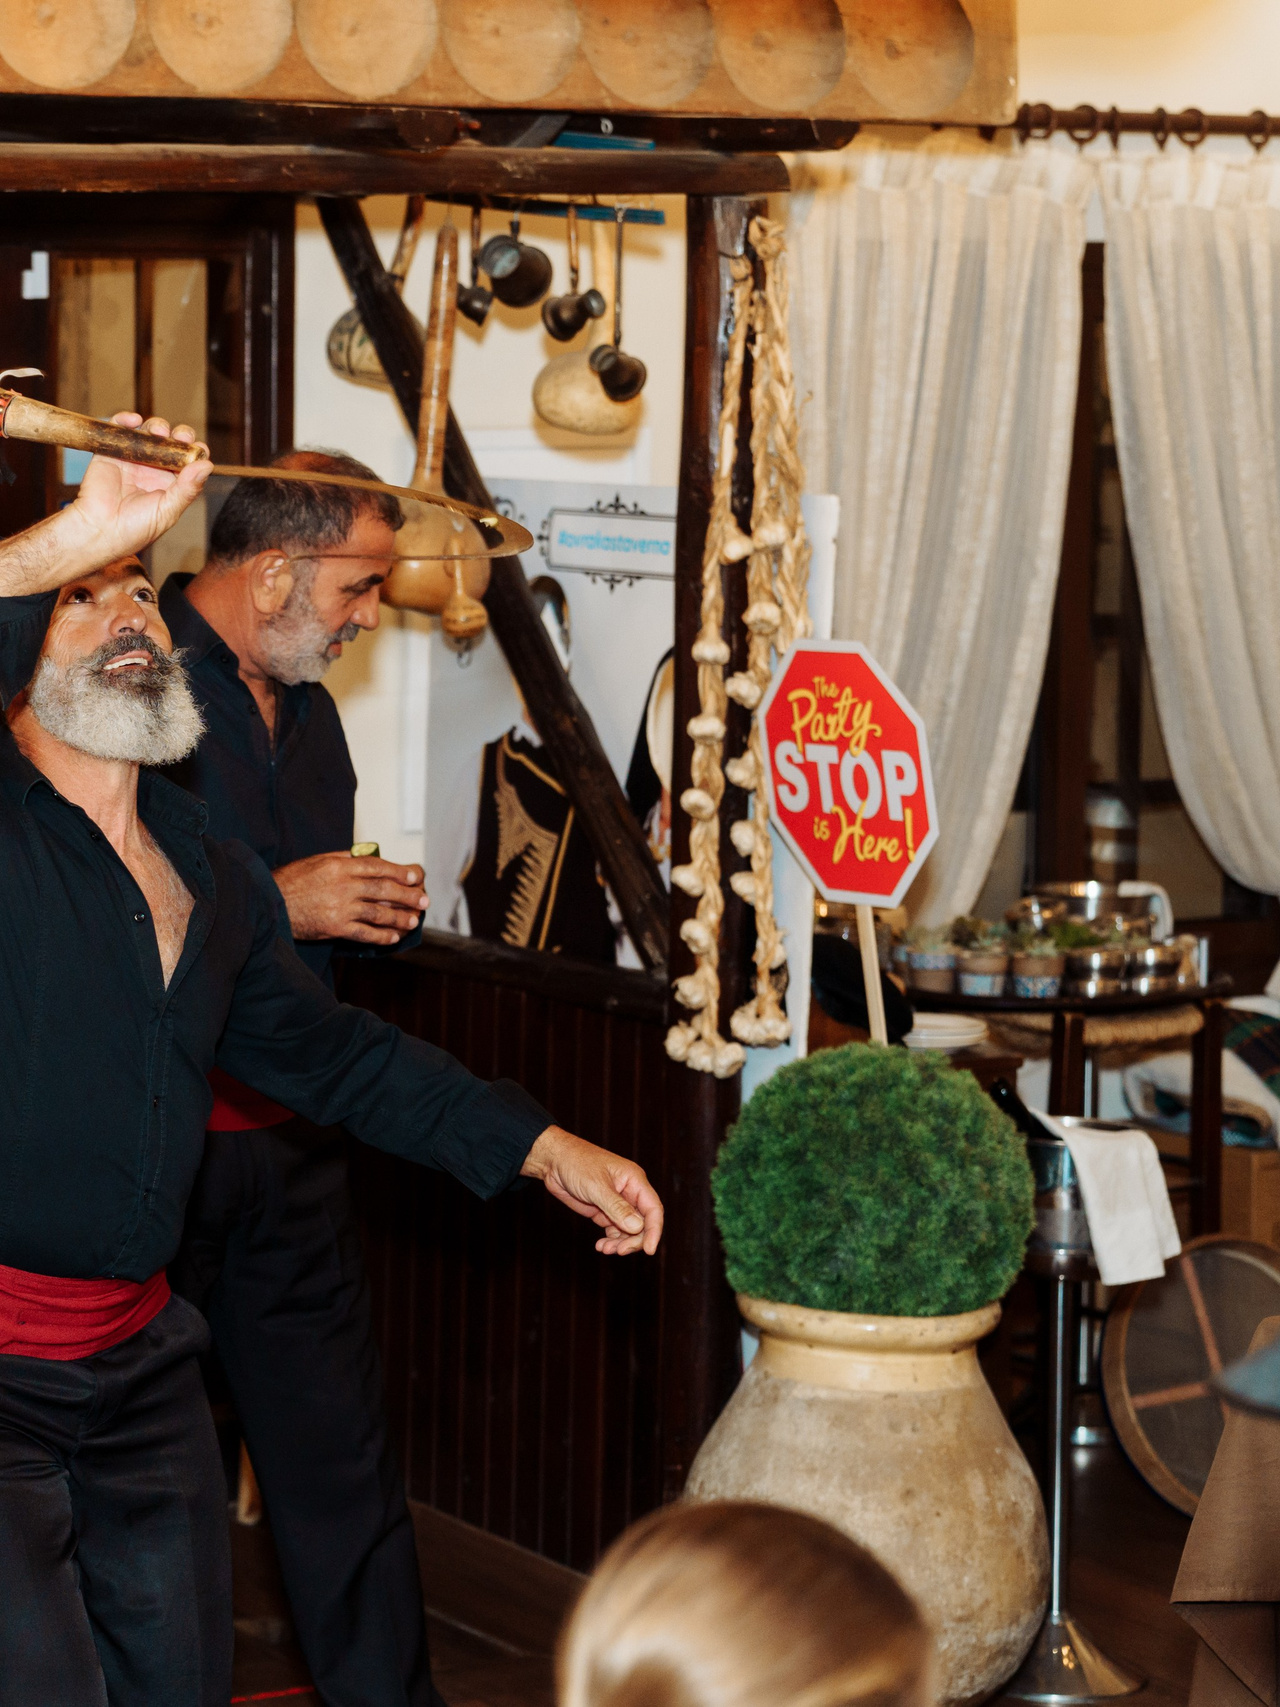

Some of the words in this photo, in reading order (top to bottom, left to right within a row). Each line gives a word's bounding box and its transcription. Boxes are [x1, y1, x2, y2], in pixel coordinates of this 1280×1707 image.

[813, 676, 839, 698] The
[787, 687, 882, 757] Party
[774, 740, 918, 821] STOP
[813, 816, 831, 841] is
[831, 801, 915, 864] Here!
